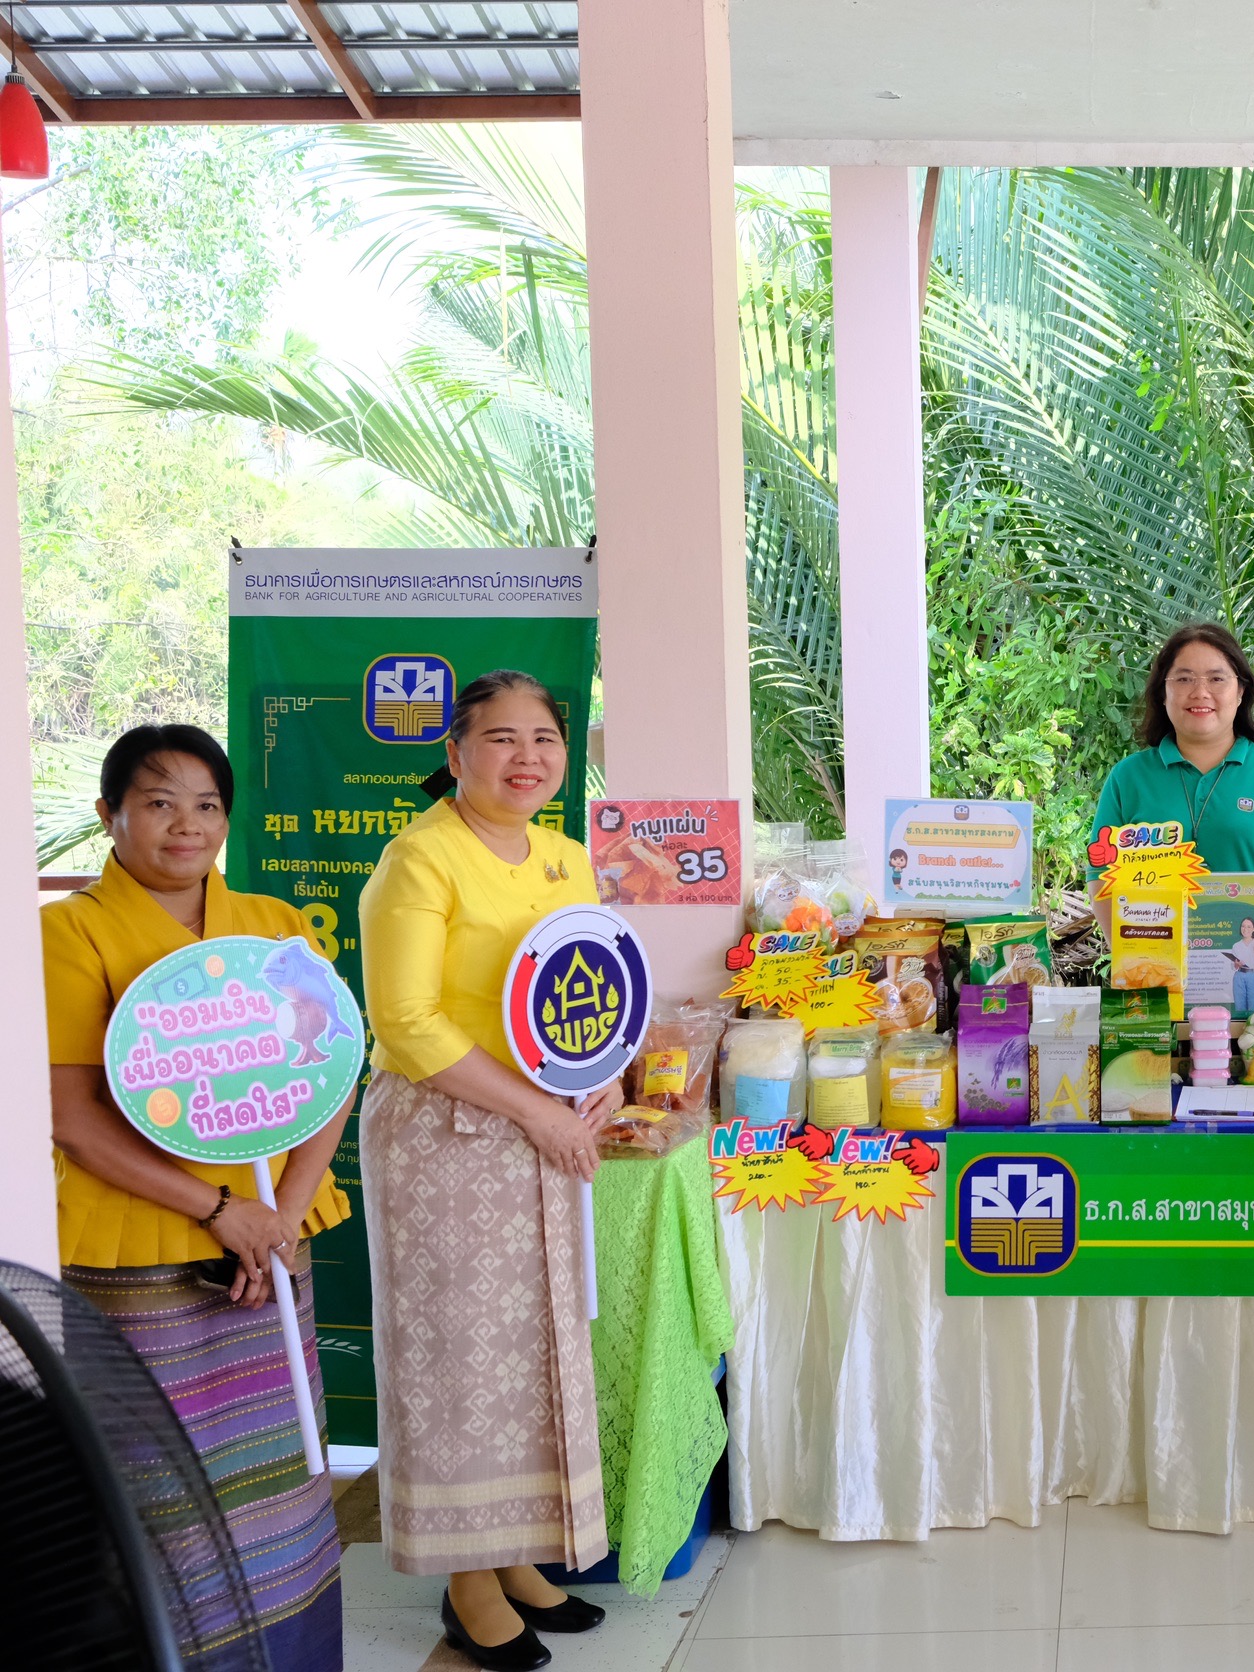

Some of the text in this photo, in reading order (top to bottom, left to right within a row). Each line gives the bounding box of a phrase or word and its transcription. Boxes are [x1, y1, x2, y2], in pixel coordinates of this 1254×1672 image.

[245, 569, 583, 588] ธนาคารเพื่อการเกษตรและสหกรณ์การเกษตร
[245, 592, 583, 602] BANK FOR AGRICULTURE AND AGRICULTURAL COOPERATIVES
[264, 813, 299, 840] ชุด
[631, 809, 706, 843] หมูแผ่น
[906, 827, 1014, 838] ธ.ก.ส.สาขาสมุทรสงคราม
[1119, 825, 1178, 848] SALE
[661, 840, 688, 852] ห่อละ
[677, 848, 728, 884] 35
[918, 853, 956, 867] Branch
[294, 876, 339, 897] เริ่มต้น
[908, 877, 1010, 891] สนับสนุนวิสาหกิจชุมชน
[1227, 883, 1239, 898] 3
[686, 893, 698, 902] ห่อ
[1123, 904, 1171, 918] Banana Hut
[758, 933, 816, 954] SALE
[122, 1033, 281, 1085] เพื่ออนาคต
[713, 1122, 789, 1158] New!
[335, 1153, 345, 1162] 10
